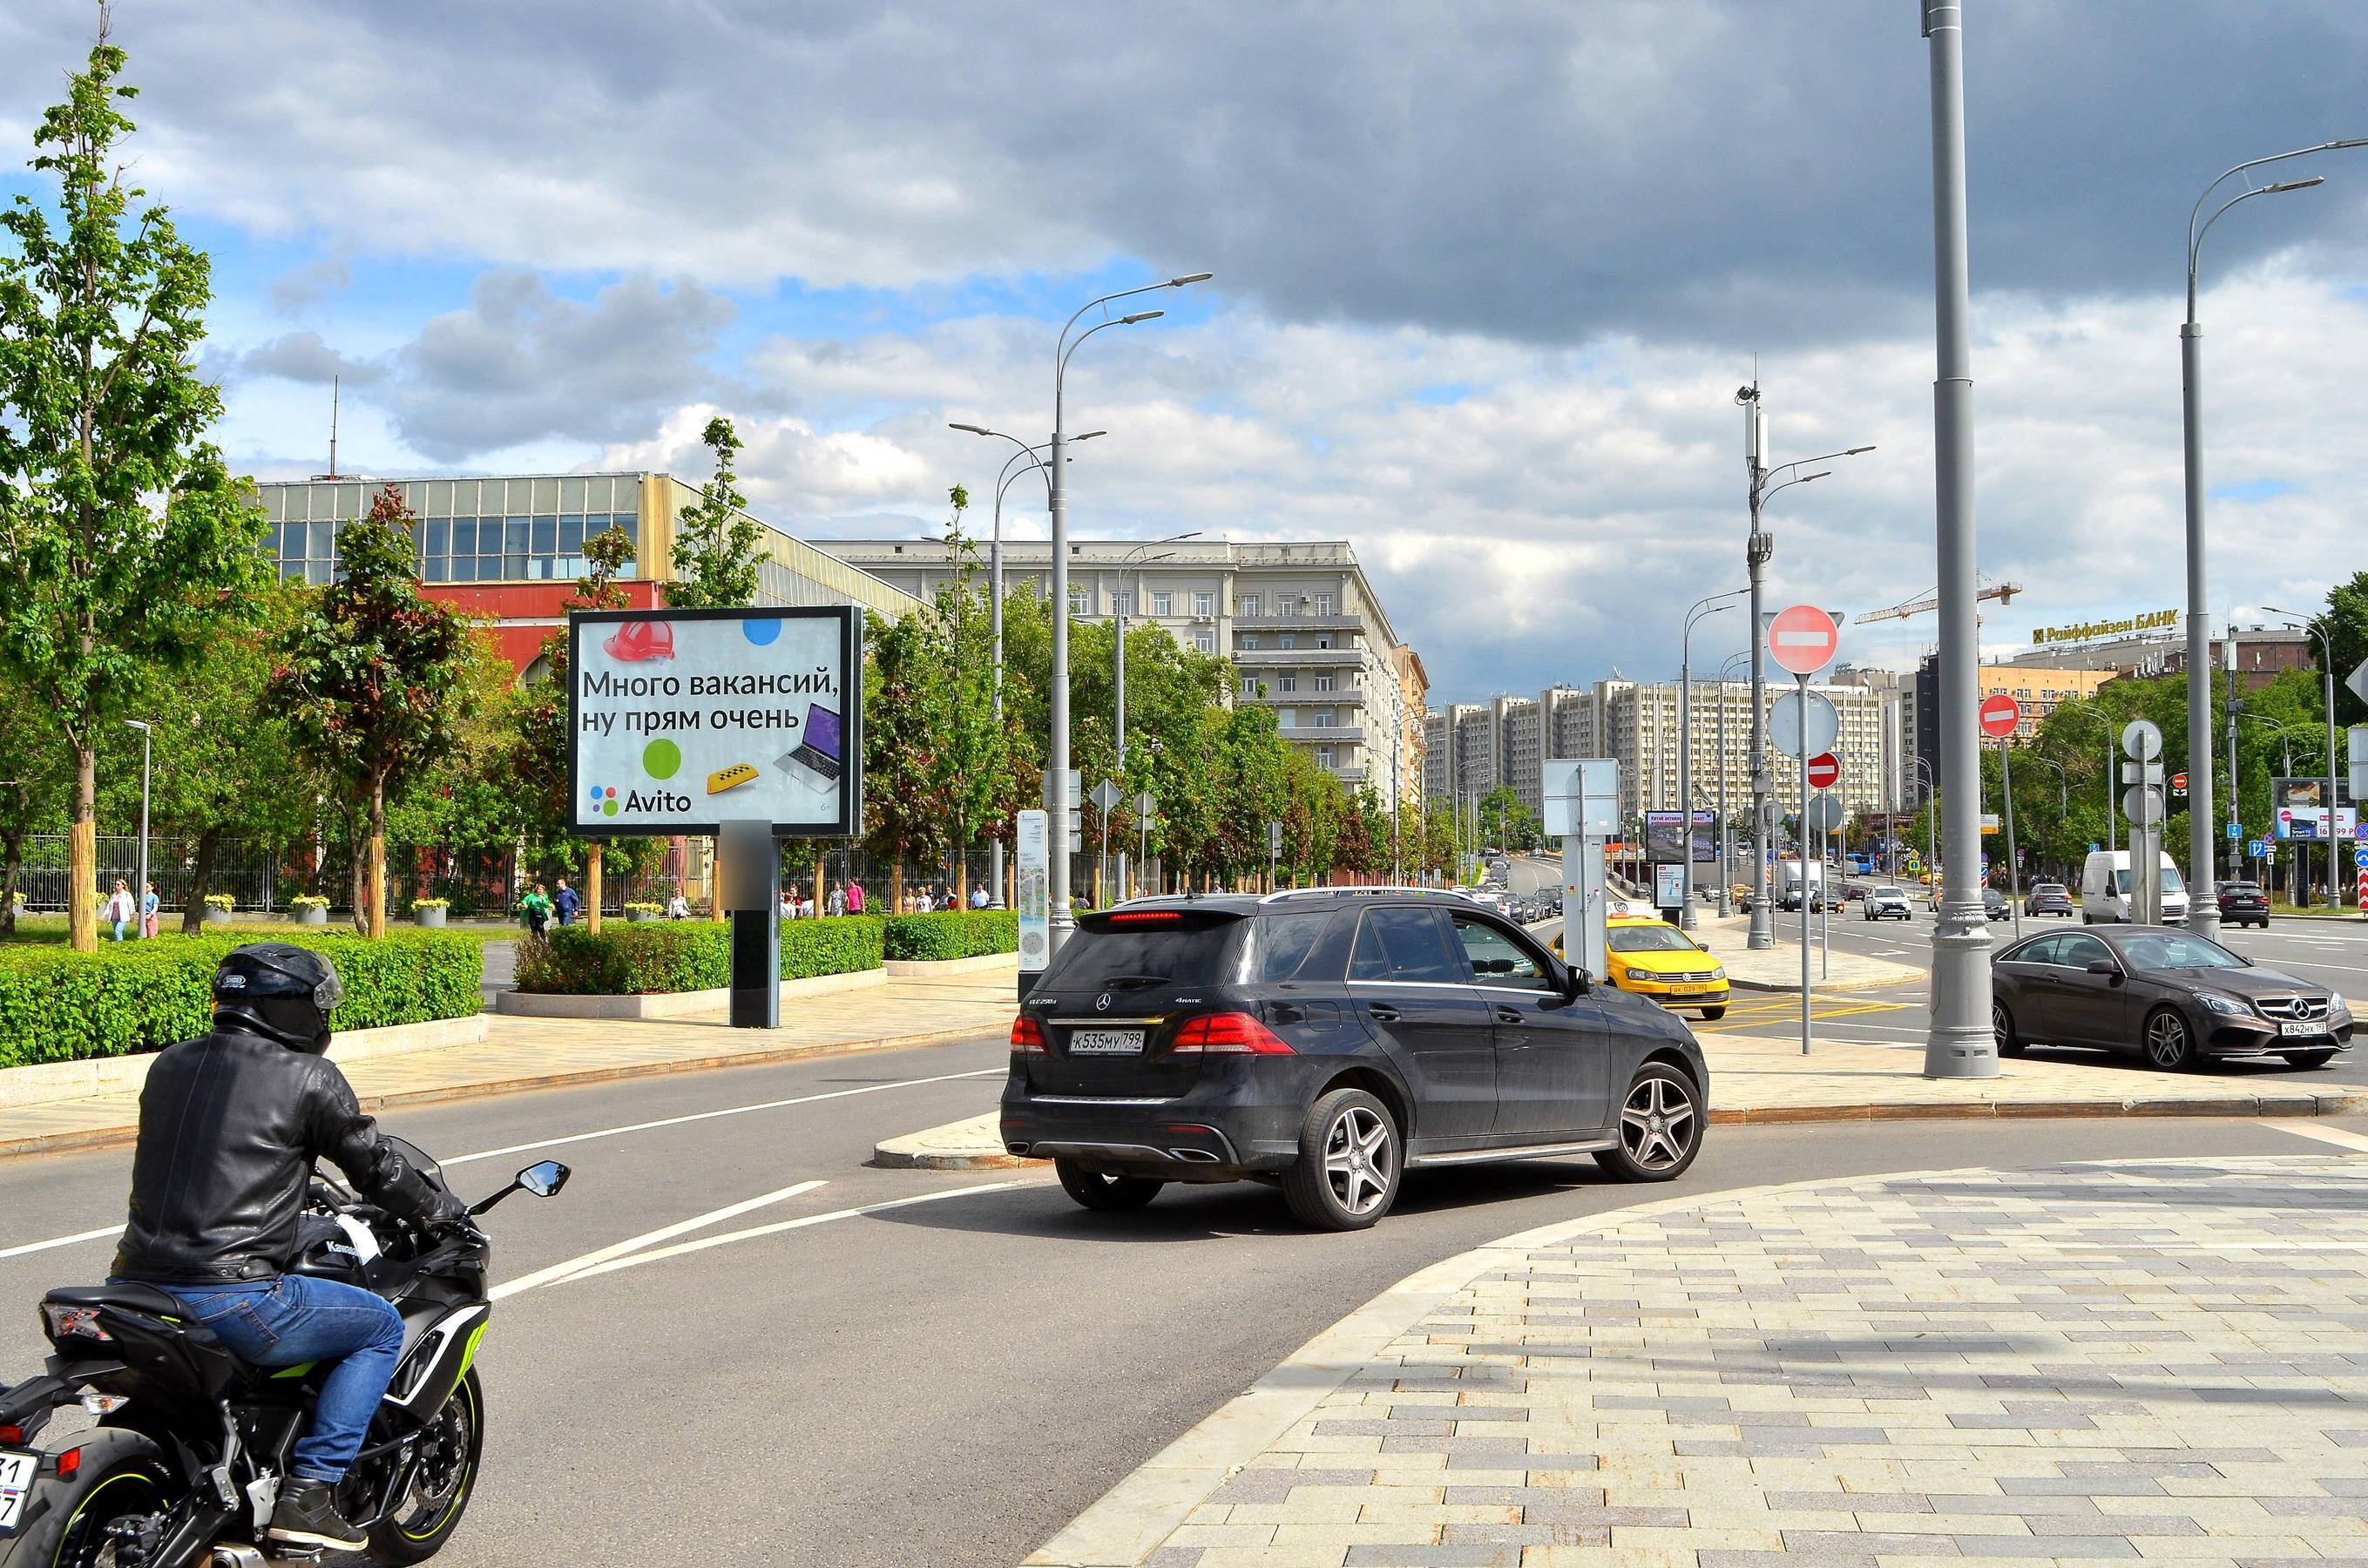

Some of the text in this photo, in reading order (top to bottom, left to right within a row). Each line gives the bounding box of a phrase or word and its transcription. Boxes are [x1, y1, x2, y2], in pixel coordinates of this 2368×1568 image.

[2047, 609, 2178, 642] Райффайзен БАНК
[583, 666, 839, 698] Много вакансий,
[582, 707, 800, 737] ну прям очень
[625, 789, 692, 813] Avito
[1122, 1032, 1141, 1045] 799
